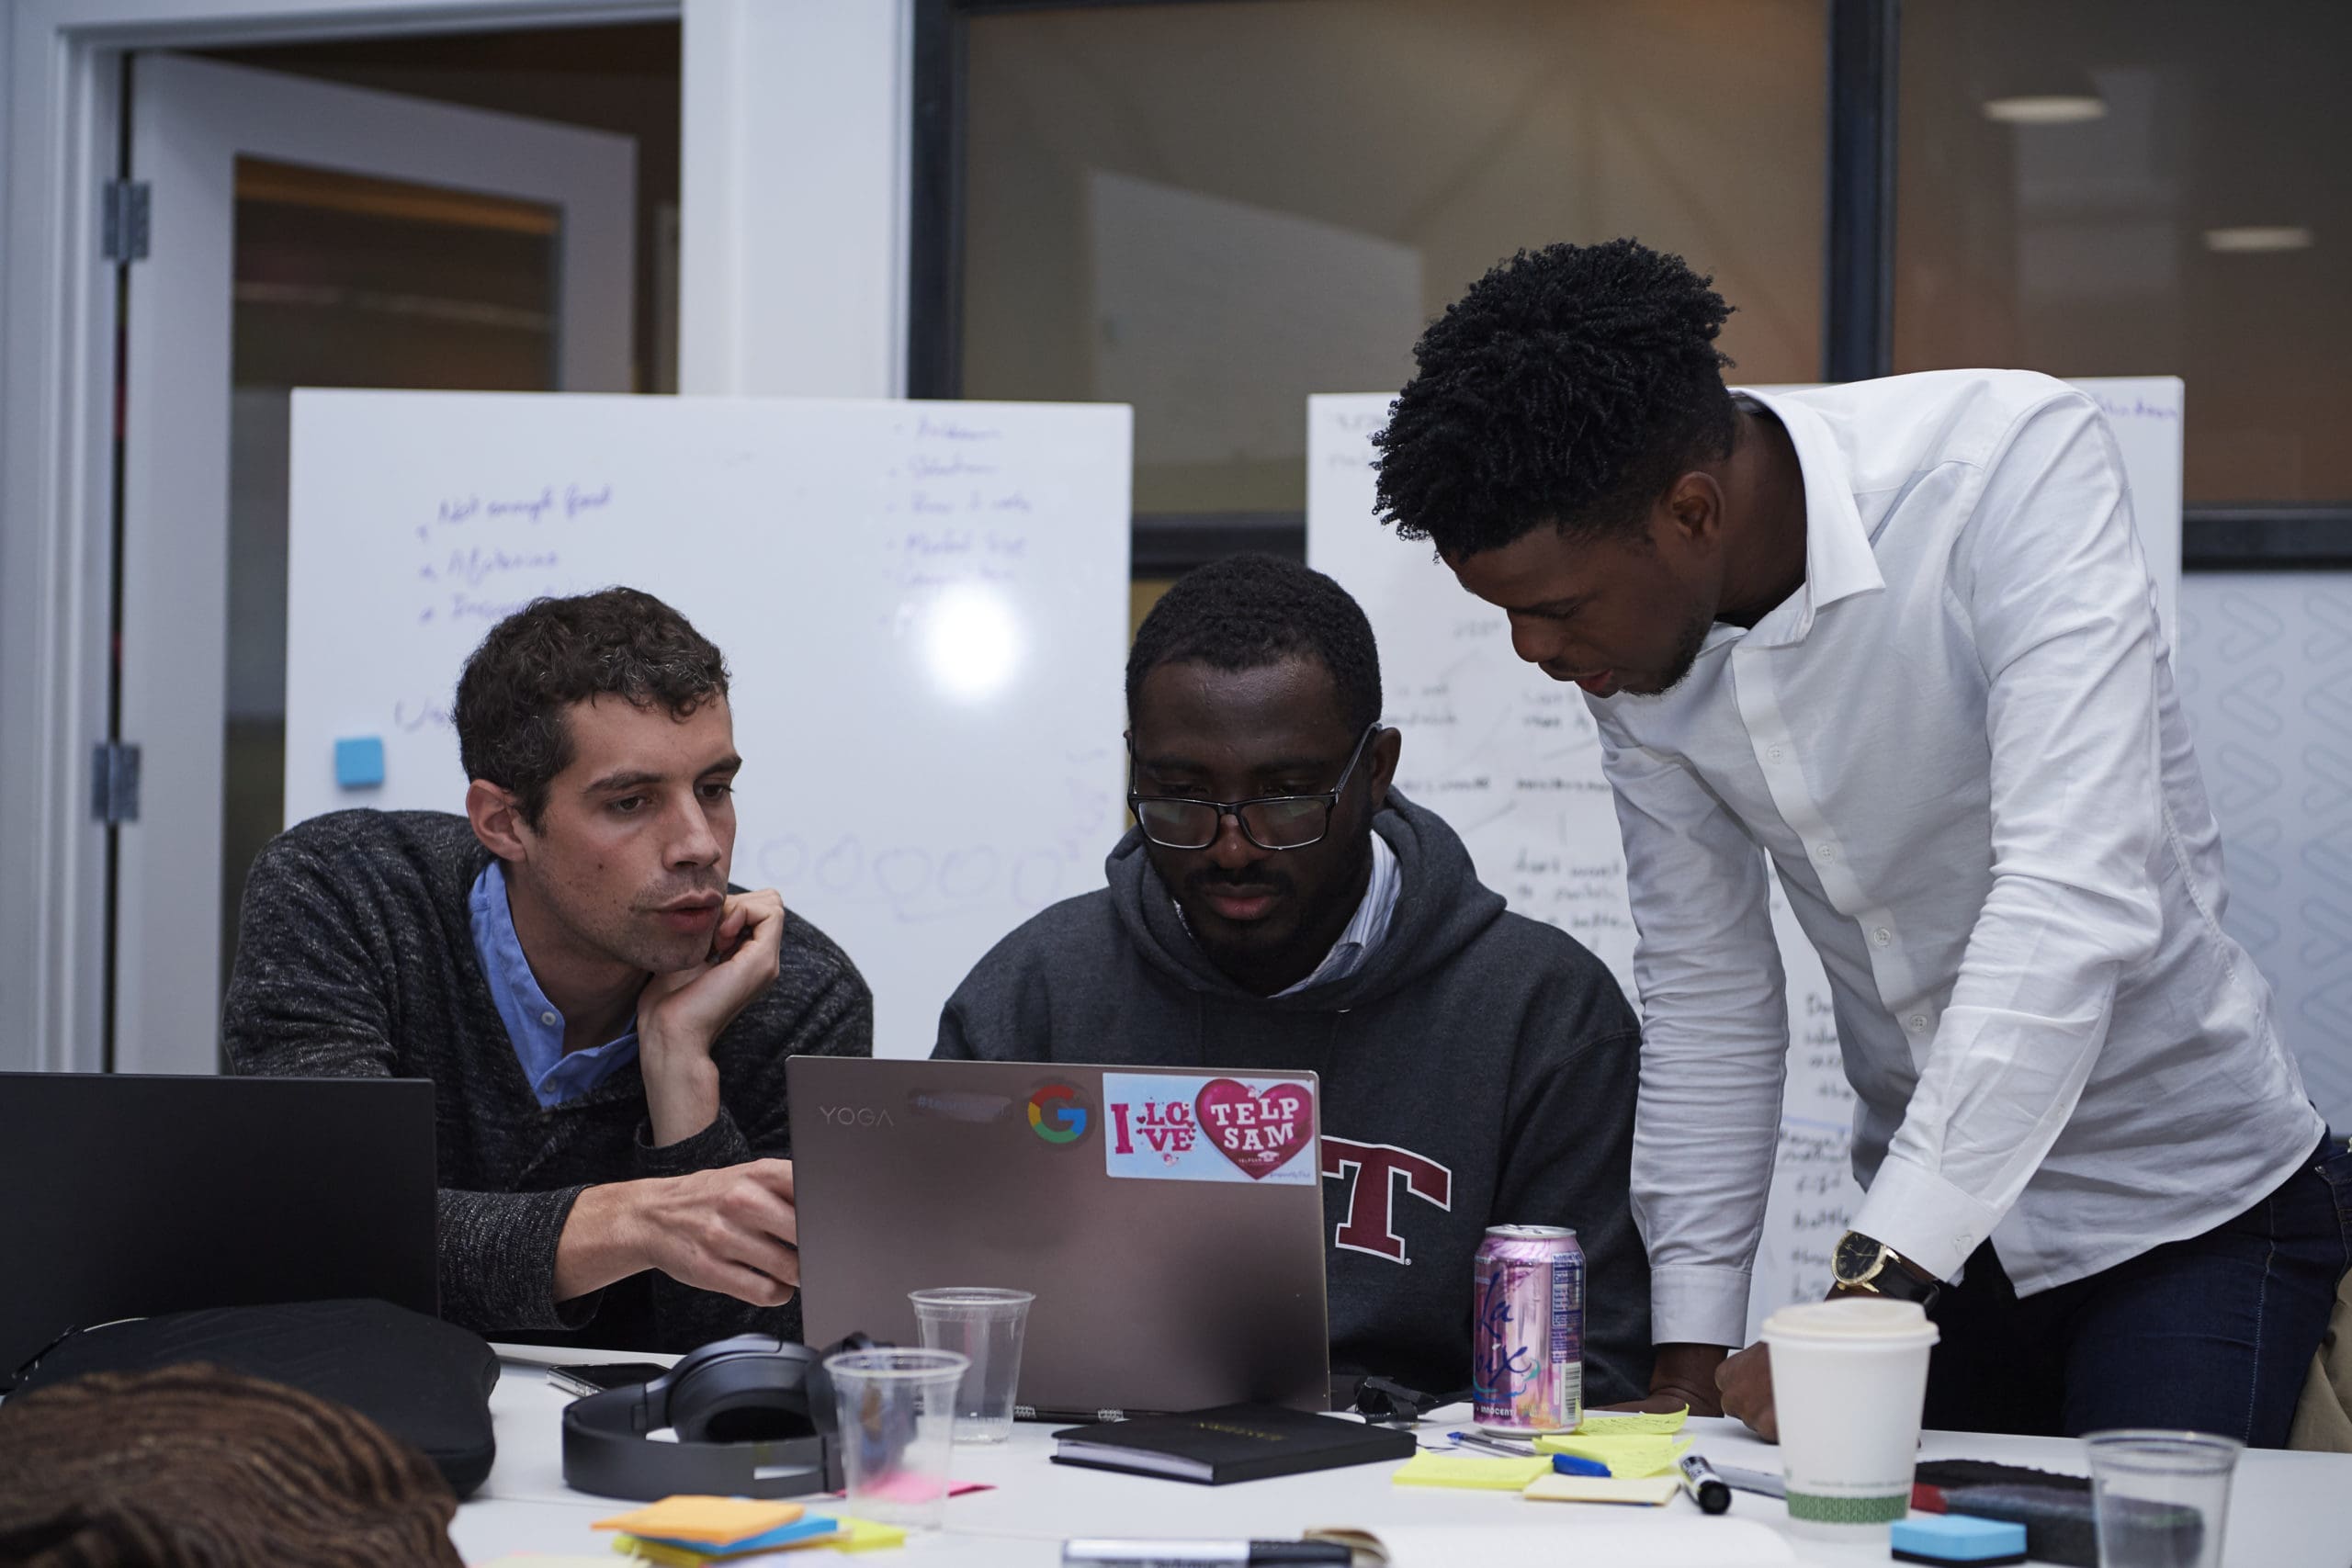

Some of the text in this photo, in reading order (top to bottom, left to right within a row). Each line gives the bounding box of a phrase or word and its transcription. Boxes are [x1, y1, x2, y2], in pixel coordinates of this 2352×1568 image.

[820, 1106, 894, 1127] YOGA
[1211, 1098, 1299, 1126] TELP
[1111, 1103, 1134, 1154] I
[1224, 1122, 1294, 1151] SAM
[1481, 1404, 1514, 1416] INNOCENT
